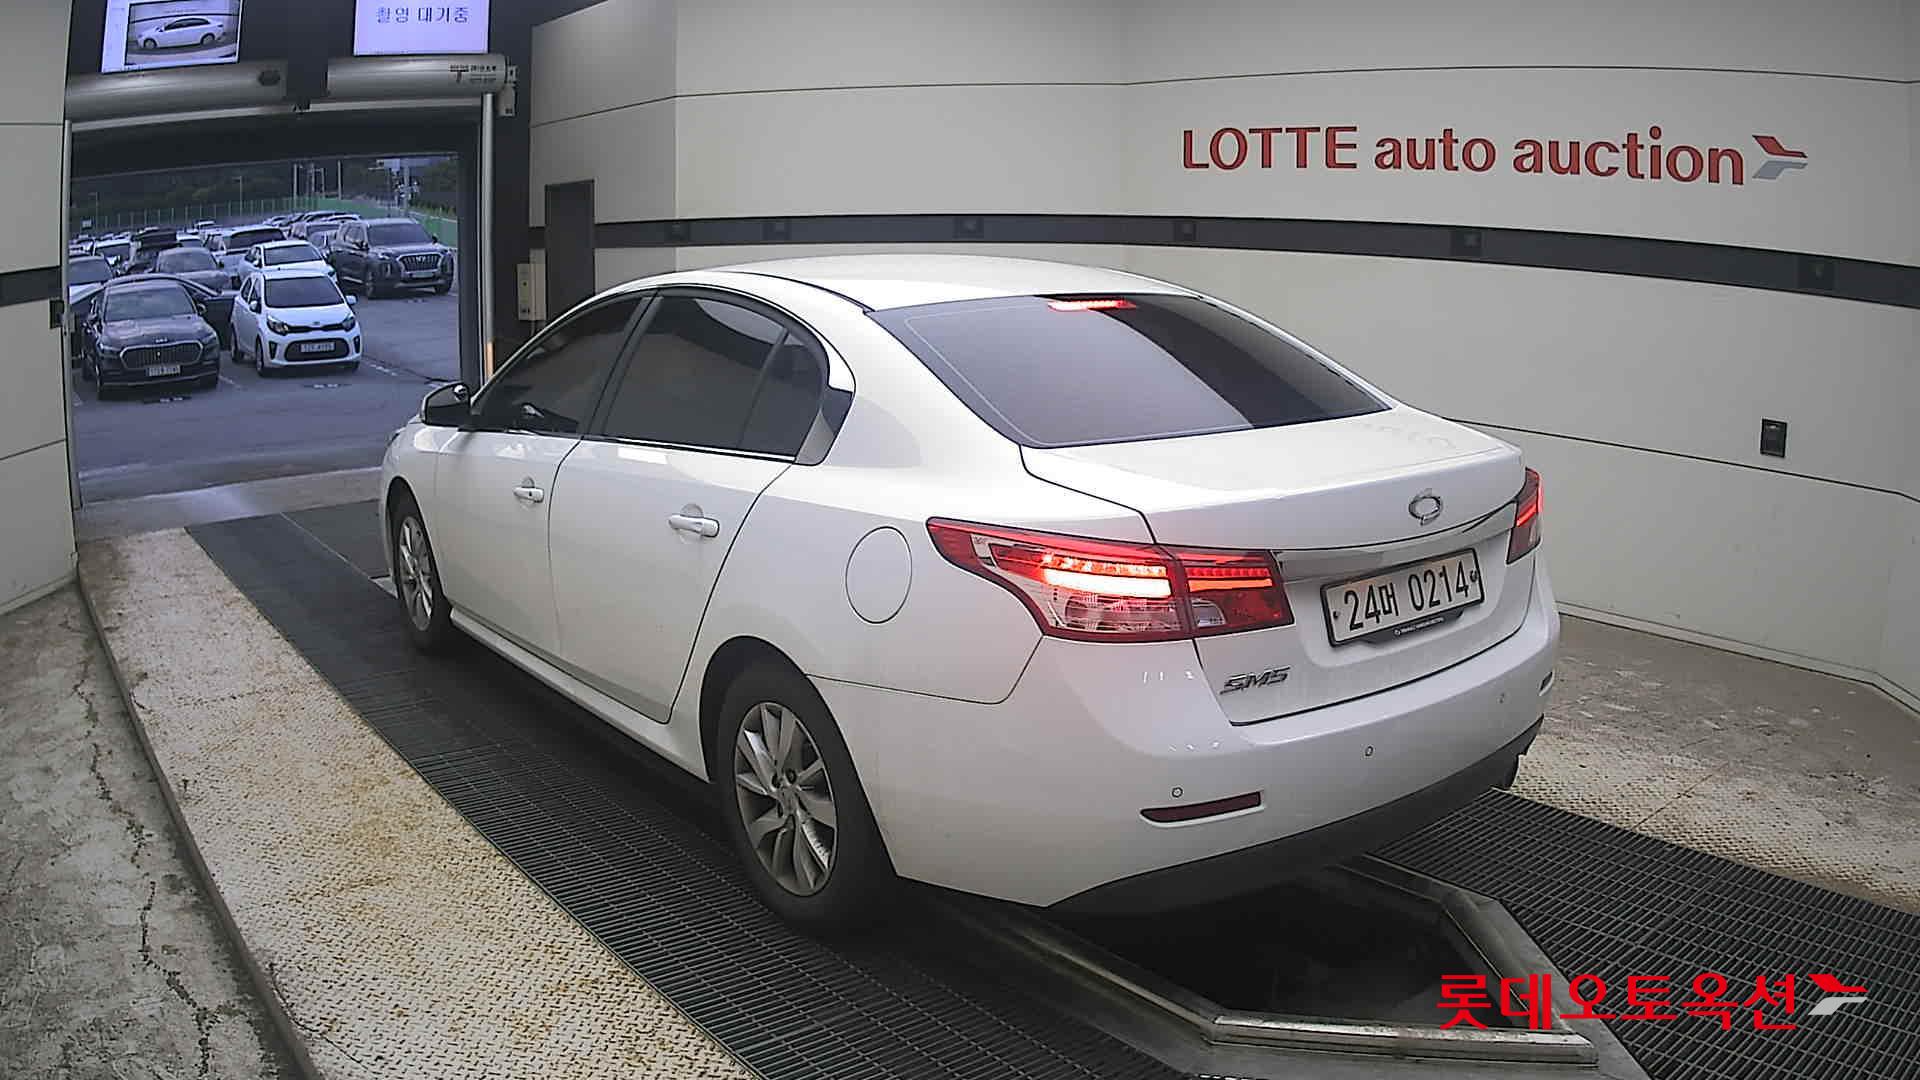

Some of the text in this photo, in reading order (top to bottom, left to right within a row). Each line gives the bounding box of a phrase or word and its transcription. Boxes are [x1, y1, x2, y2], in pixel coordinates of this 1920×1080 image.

[418, 7, 468, 24] 대기중
[1183, 126, 1745, 185] LOTTE auto auction
[1344, 560, 1469, 630] 24머 0214
[1220, 666, 1291, 695] SM5
